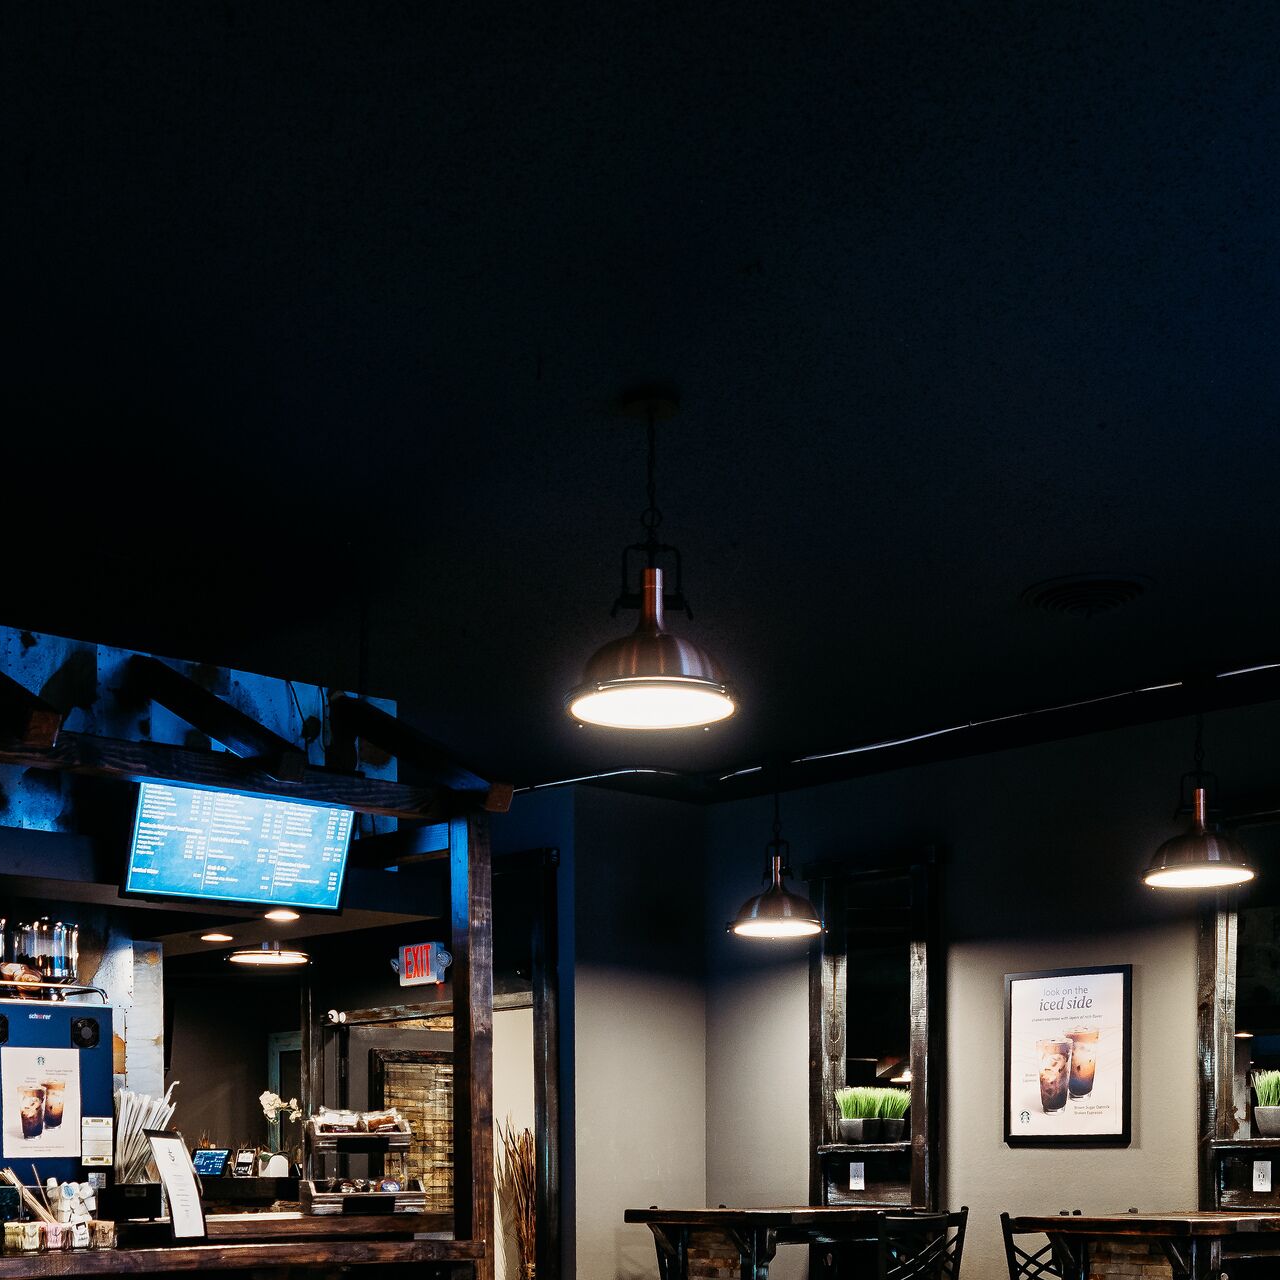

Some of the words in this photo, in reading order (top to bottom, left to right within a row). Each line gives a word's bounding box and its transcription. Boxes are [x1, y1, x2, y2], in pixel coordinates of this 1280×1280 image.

[404, 944, 431, 979] EXIT
[1044, 988, 1060, 997] look
[1075, 986, 1088, 994] the
[1039, 997, 1065, 1011] iced
[1067, 996, 1092, 1010] side
